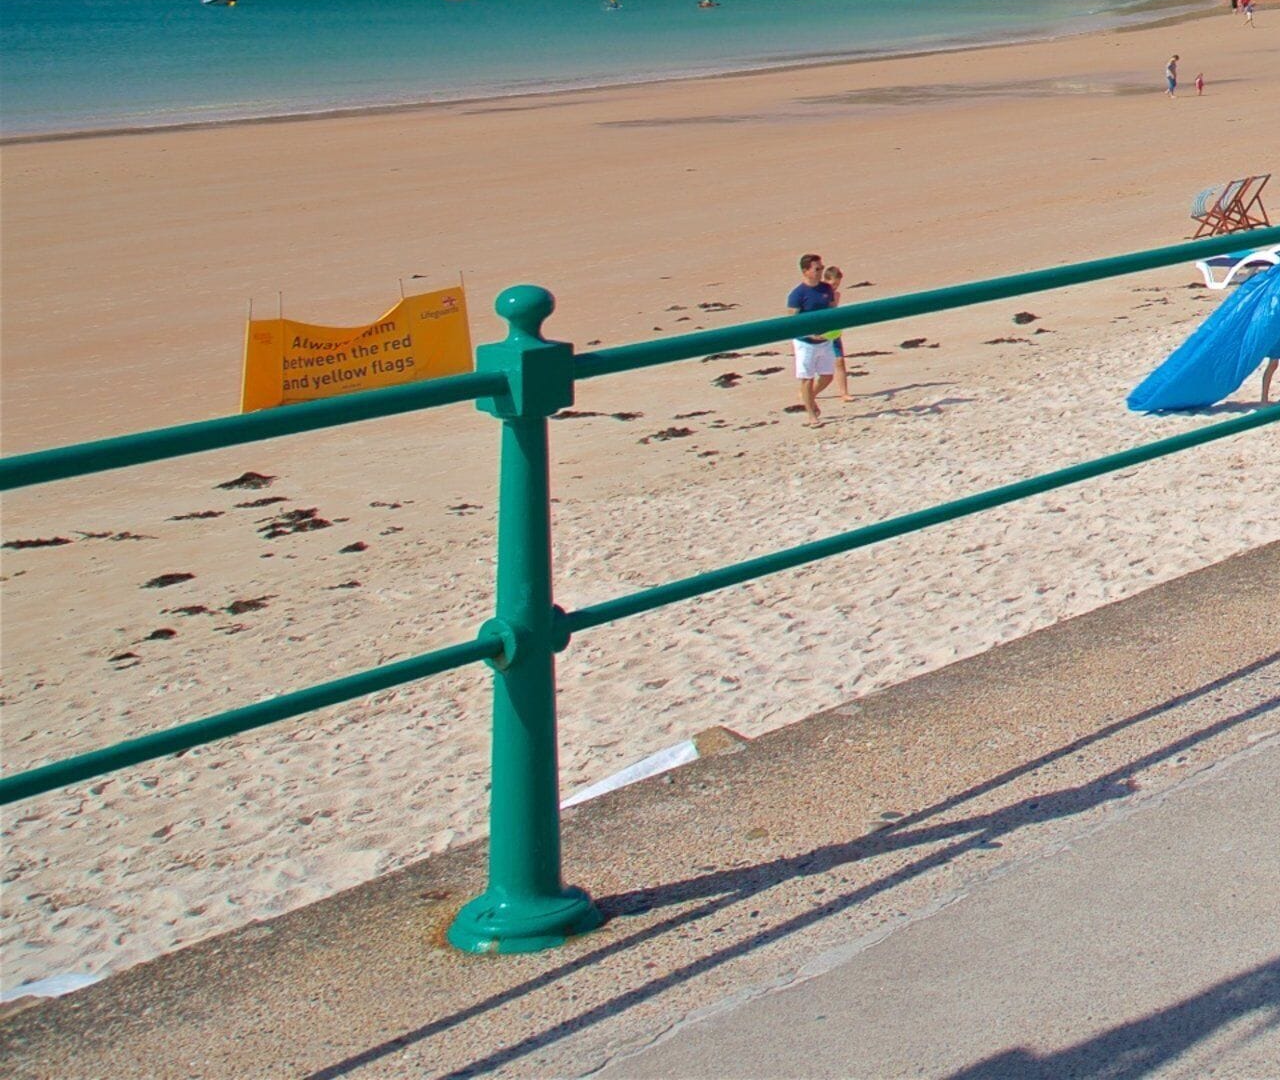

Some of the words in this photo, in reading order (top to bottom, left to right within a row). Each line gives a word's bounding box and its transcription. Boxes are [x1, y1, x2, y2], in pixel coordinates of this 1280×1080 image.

[355, 321, 395, 340] wim
[283, 352, 346, 370] between
[351, 344, 379, 358] the
[384, 334, 412, 351] red
[283, 375, 309, 390] and
[312, 367, 367, 389] yellow
[372, 357, 415, 374] flags
